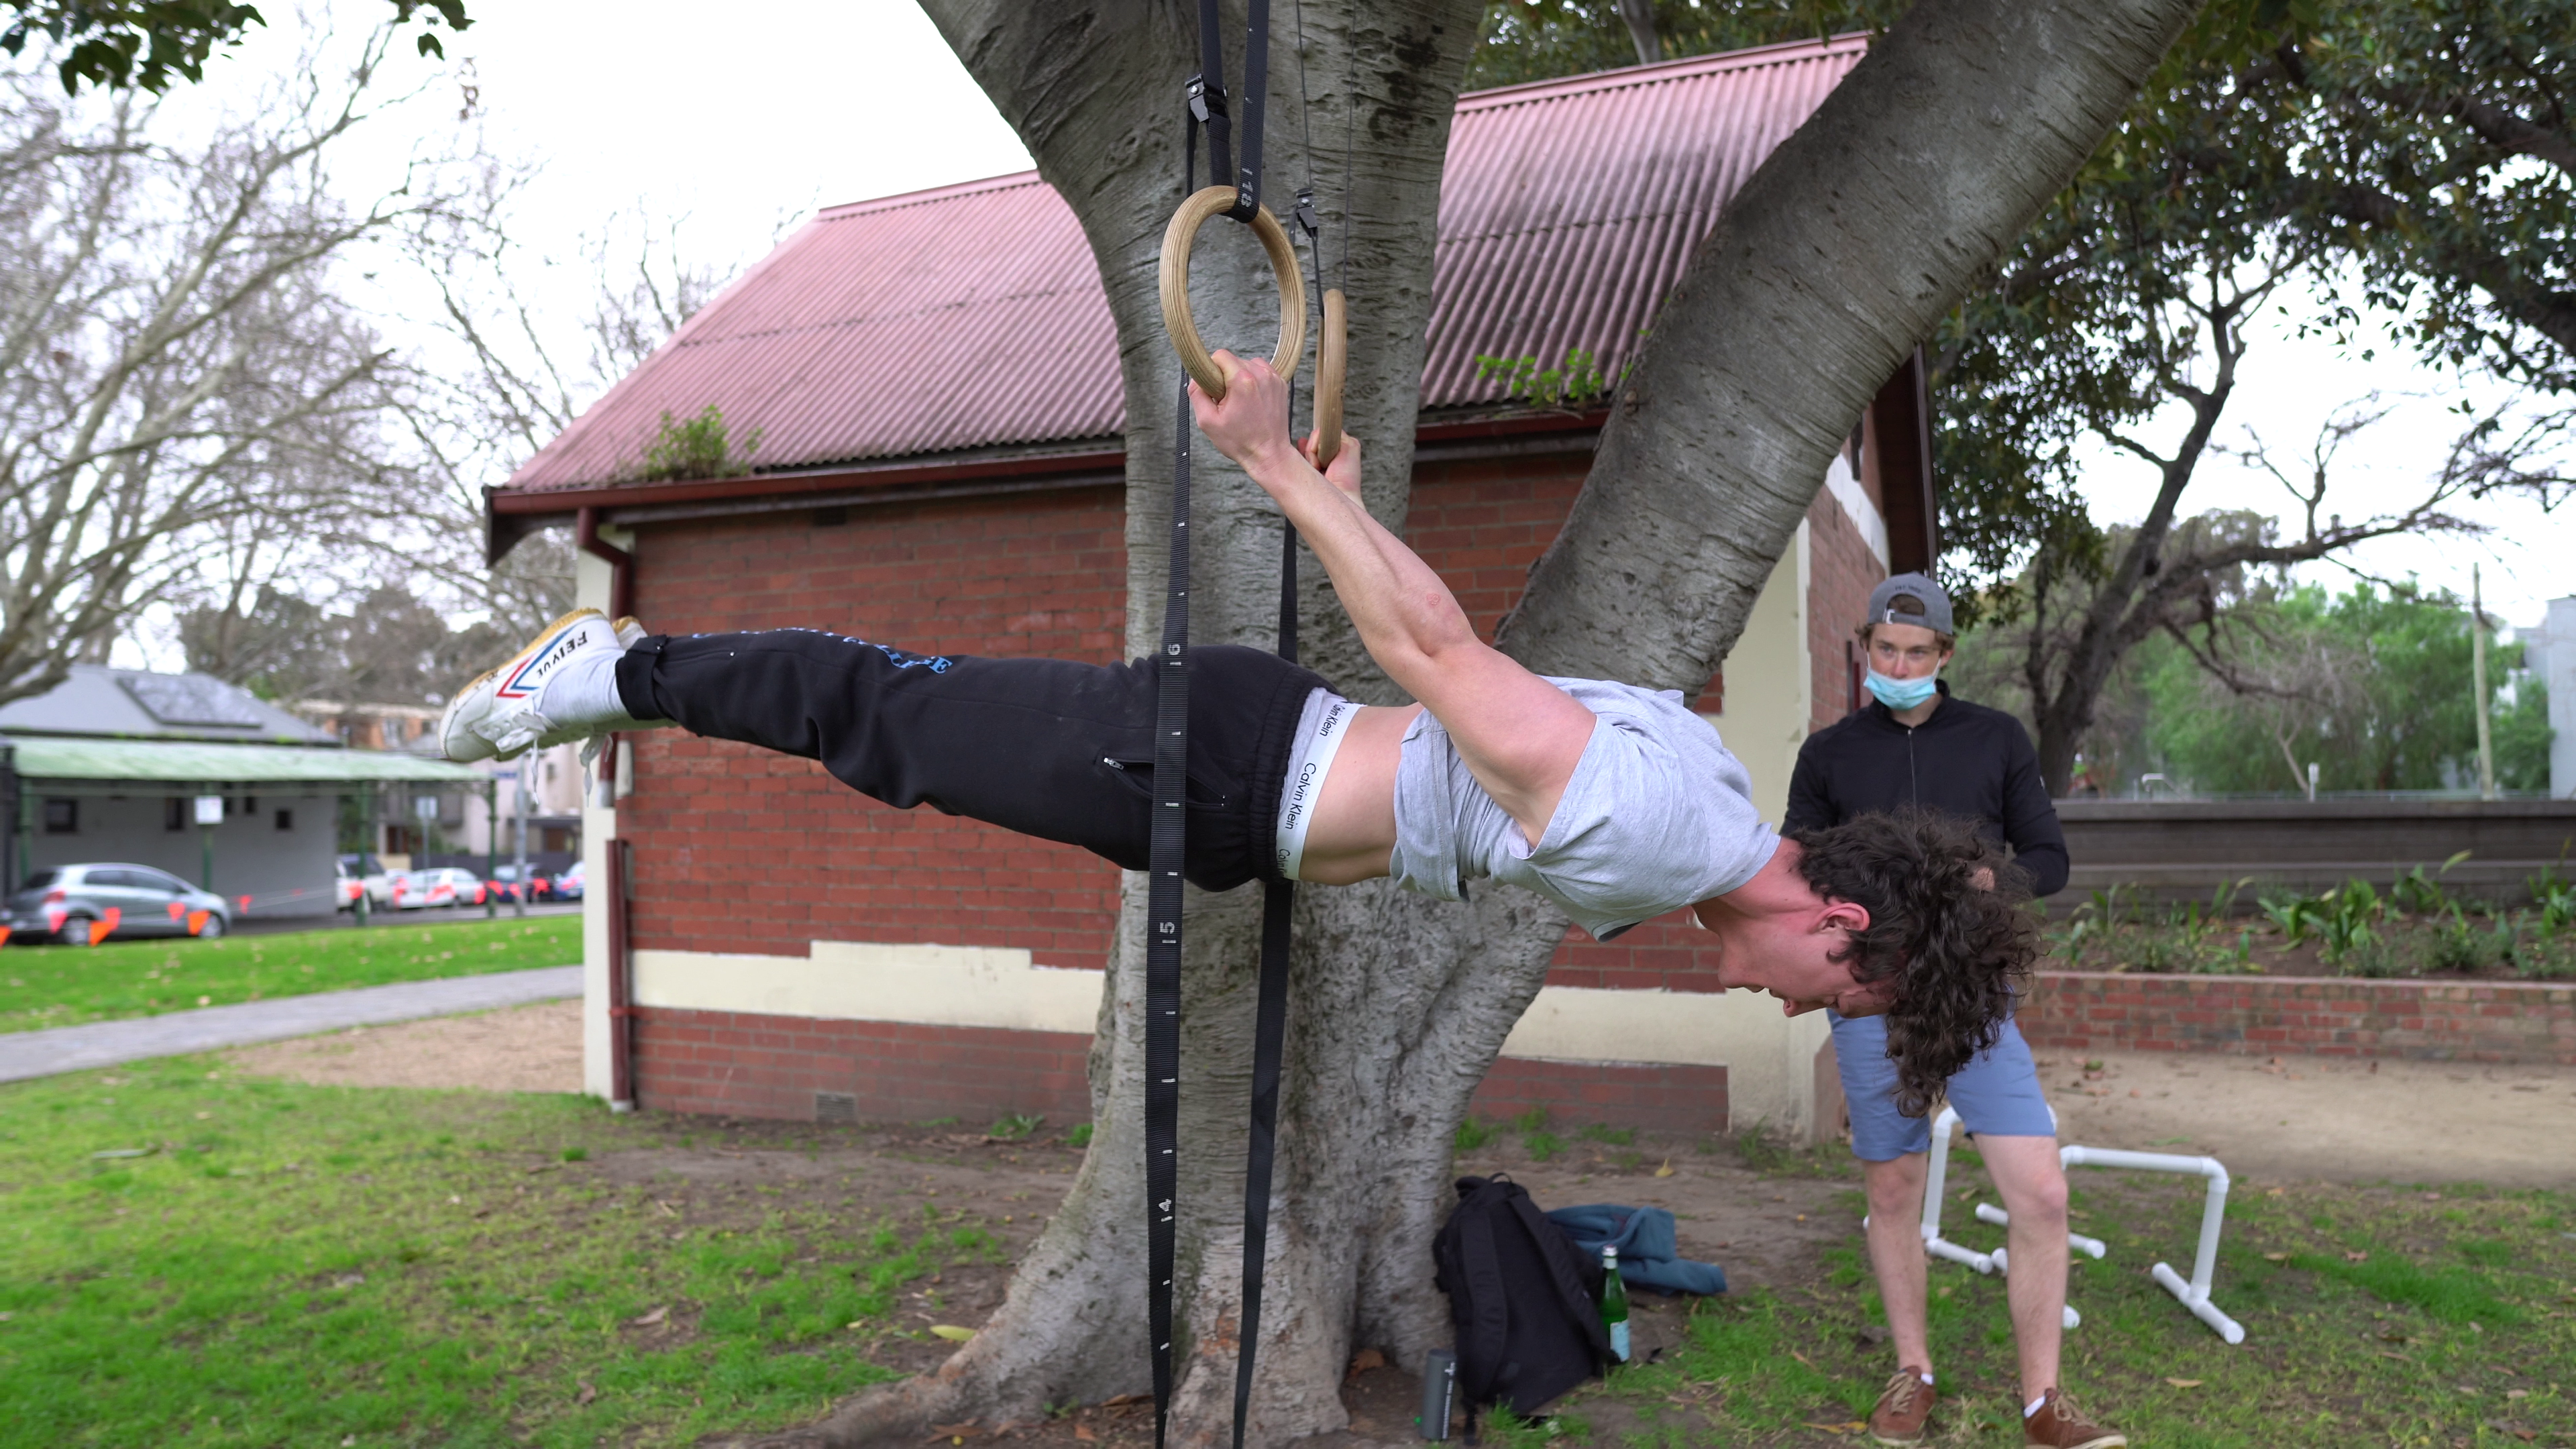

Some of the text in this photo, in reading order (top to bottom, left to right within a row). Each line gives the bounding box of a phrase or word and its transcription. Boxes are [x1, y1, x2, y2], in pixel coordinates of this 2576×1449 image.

[536, 631, 588, 679] FEIYUE
[1319, 704, 1346, 737] Calvin Klein
[1285, 762, 1317, 830] Calvin Klein
